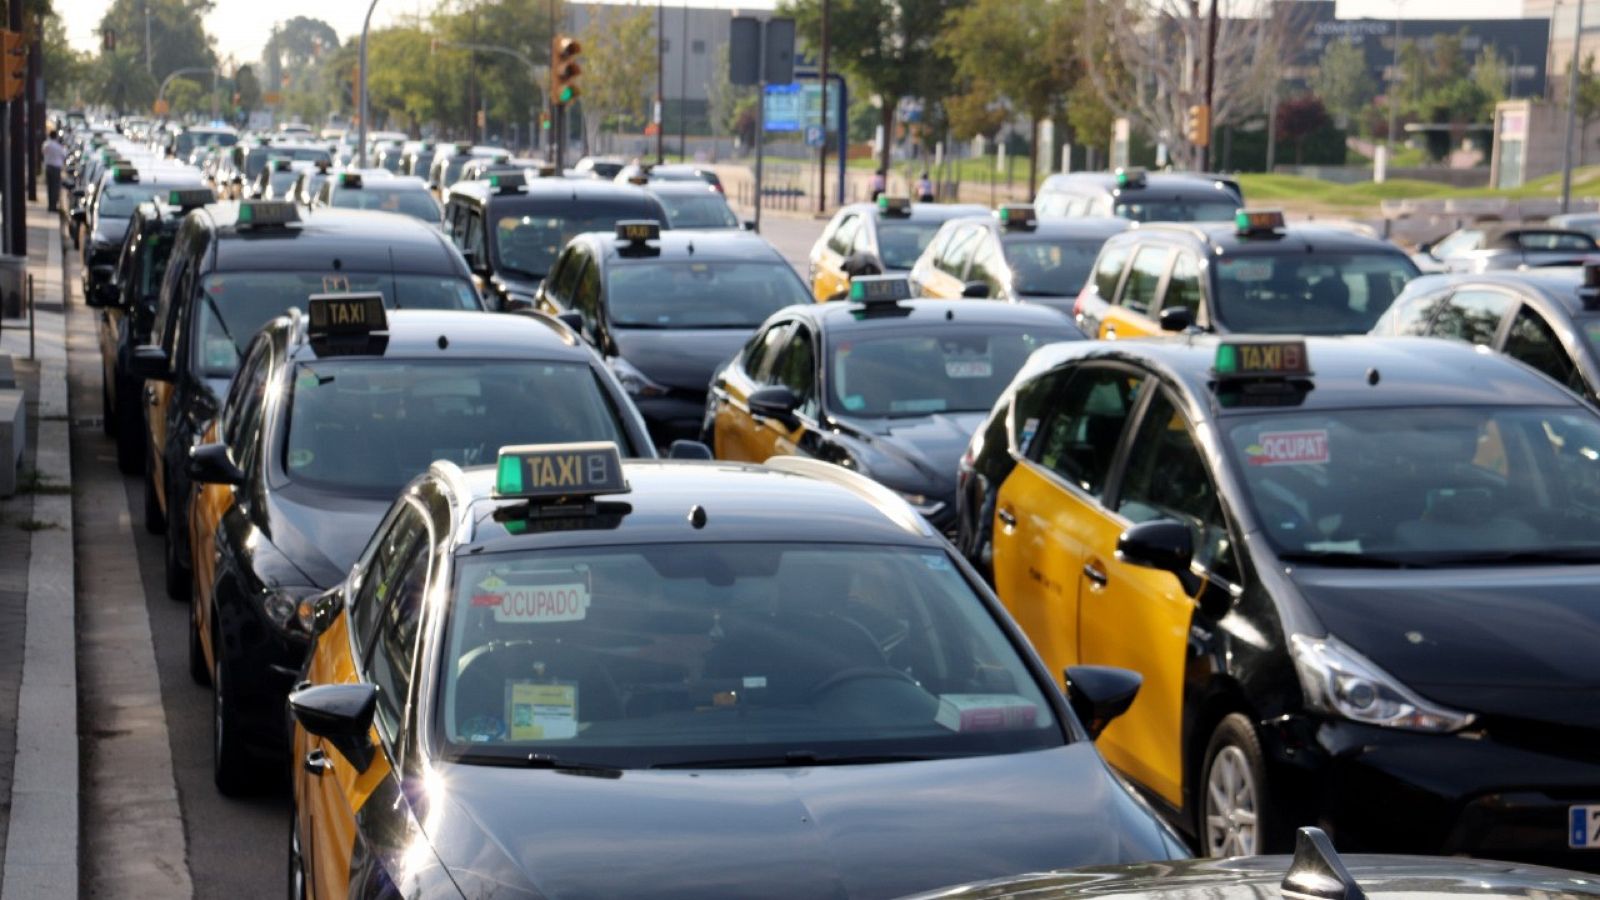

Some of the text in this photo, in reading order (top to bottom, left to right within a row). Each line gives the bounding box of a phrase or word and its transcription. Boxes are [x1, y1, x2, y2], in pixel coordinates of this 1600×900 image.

[328, 303, 365, 324] TAXI
[1240, 344, 1281, 370] TAXI
[1263, 436, 1325, 459] OCUPAT
[527, 455, 582, 487] TAXI
[501, 589, 579, 617] OCUPADO
